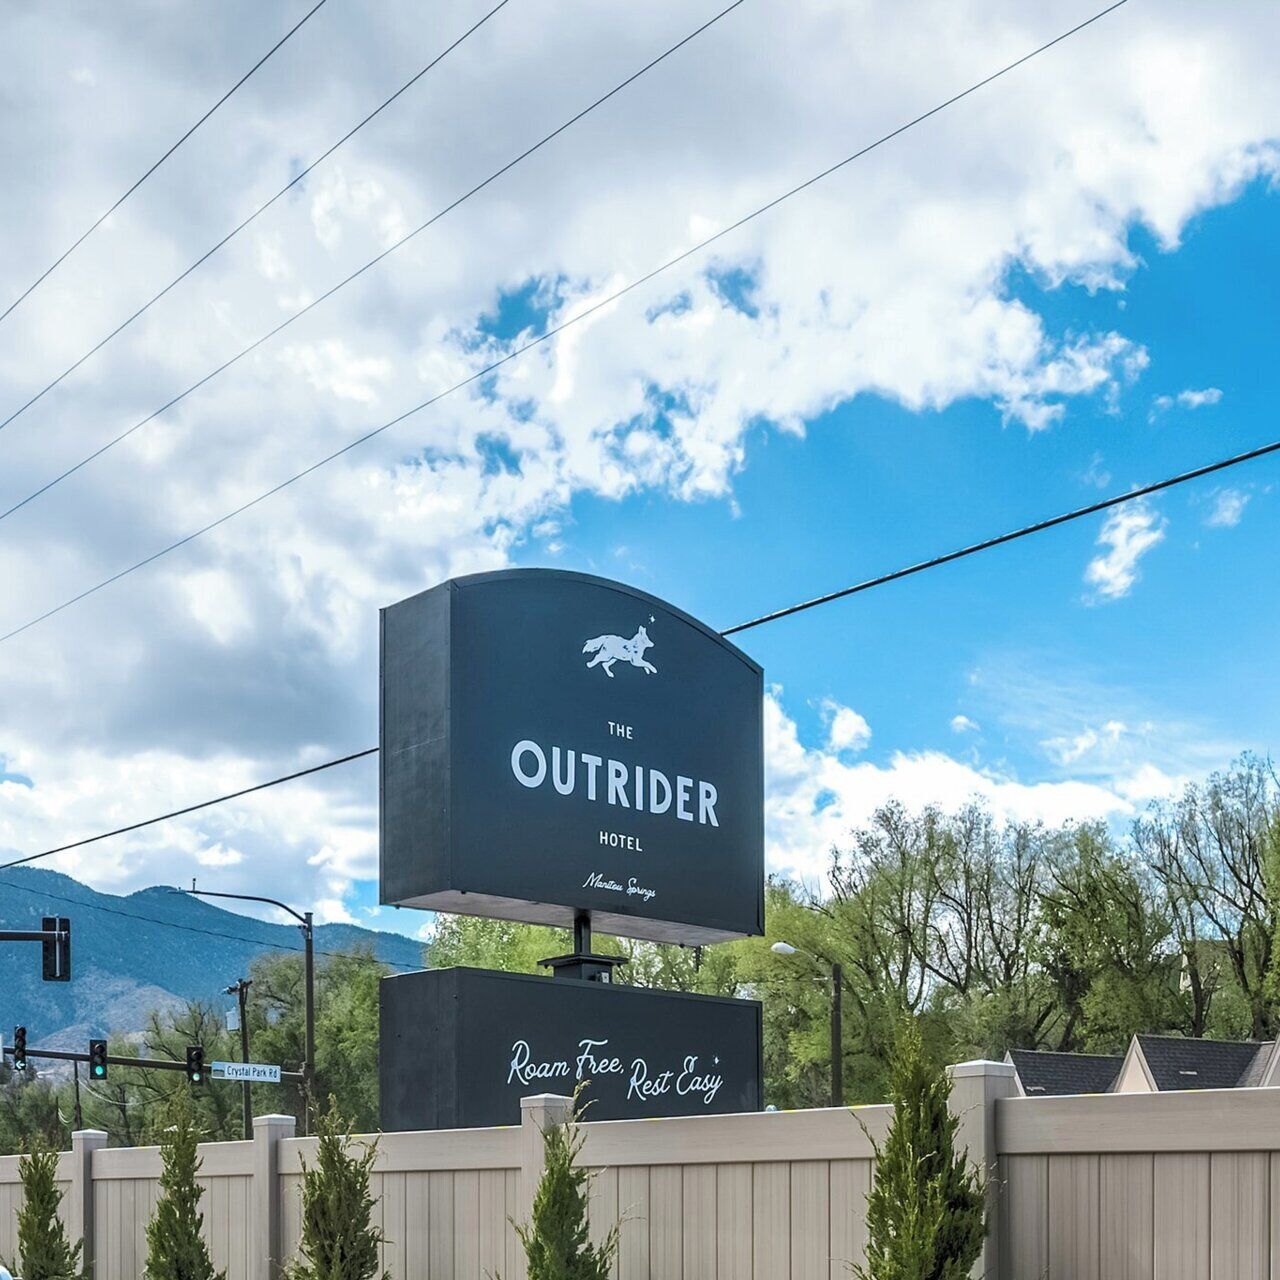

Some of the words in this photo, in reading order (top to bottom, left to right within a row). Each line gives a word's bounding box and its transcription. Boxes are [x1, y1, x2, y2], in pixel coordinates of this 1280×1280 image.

[608, 721, 634, 740] THE
[511, 739, 720, 828] OUTRIDER
[599, 830, 643, 852] HOTEL
[582, 871, 623, 891] Manitou
[626, 877, 656, 901] Springs
[227, 1065, 251, 1077] Crystal
[252, 1067, 267, 1077] Park
[269, 1068, 278, 1078] Rd
[507, 1040, 570, 1085] Roam
[576, 1039, 625, 1080] Free,
[627, 1058, 674, 1101] Rest
[676, 1055, 724, 1104] Easy
